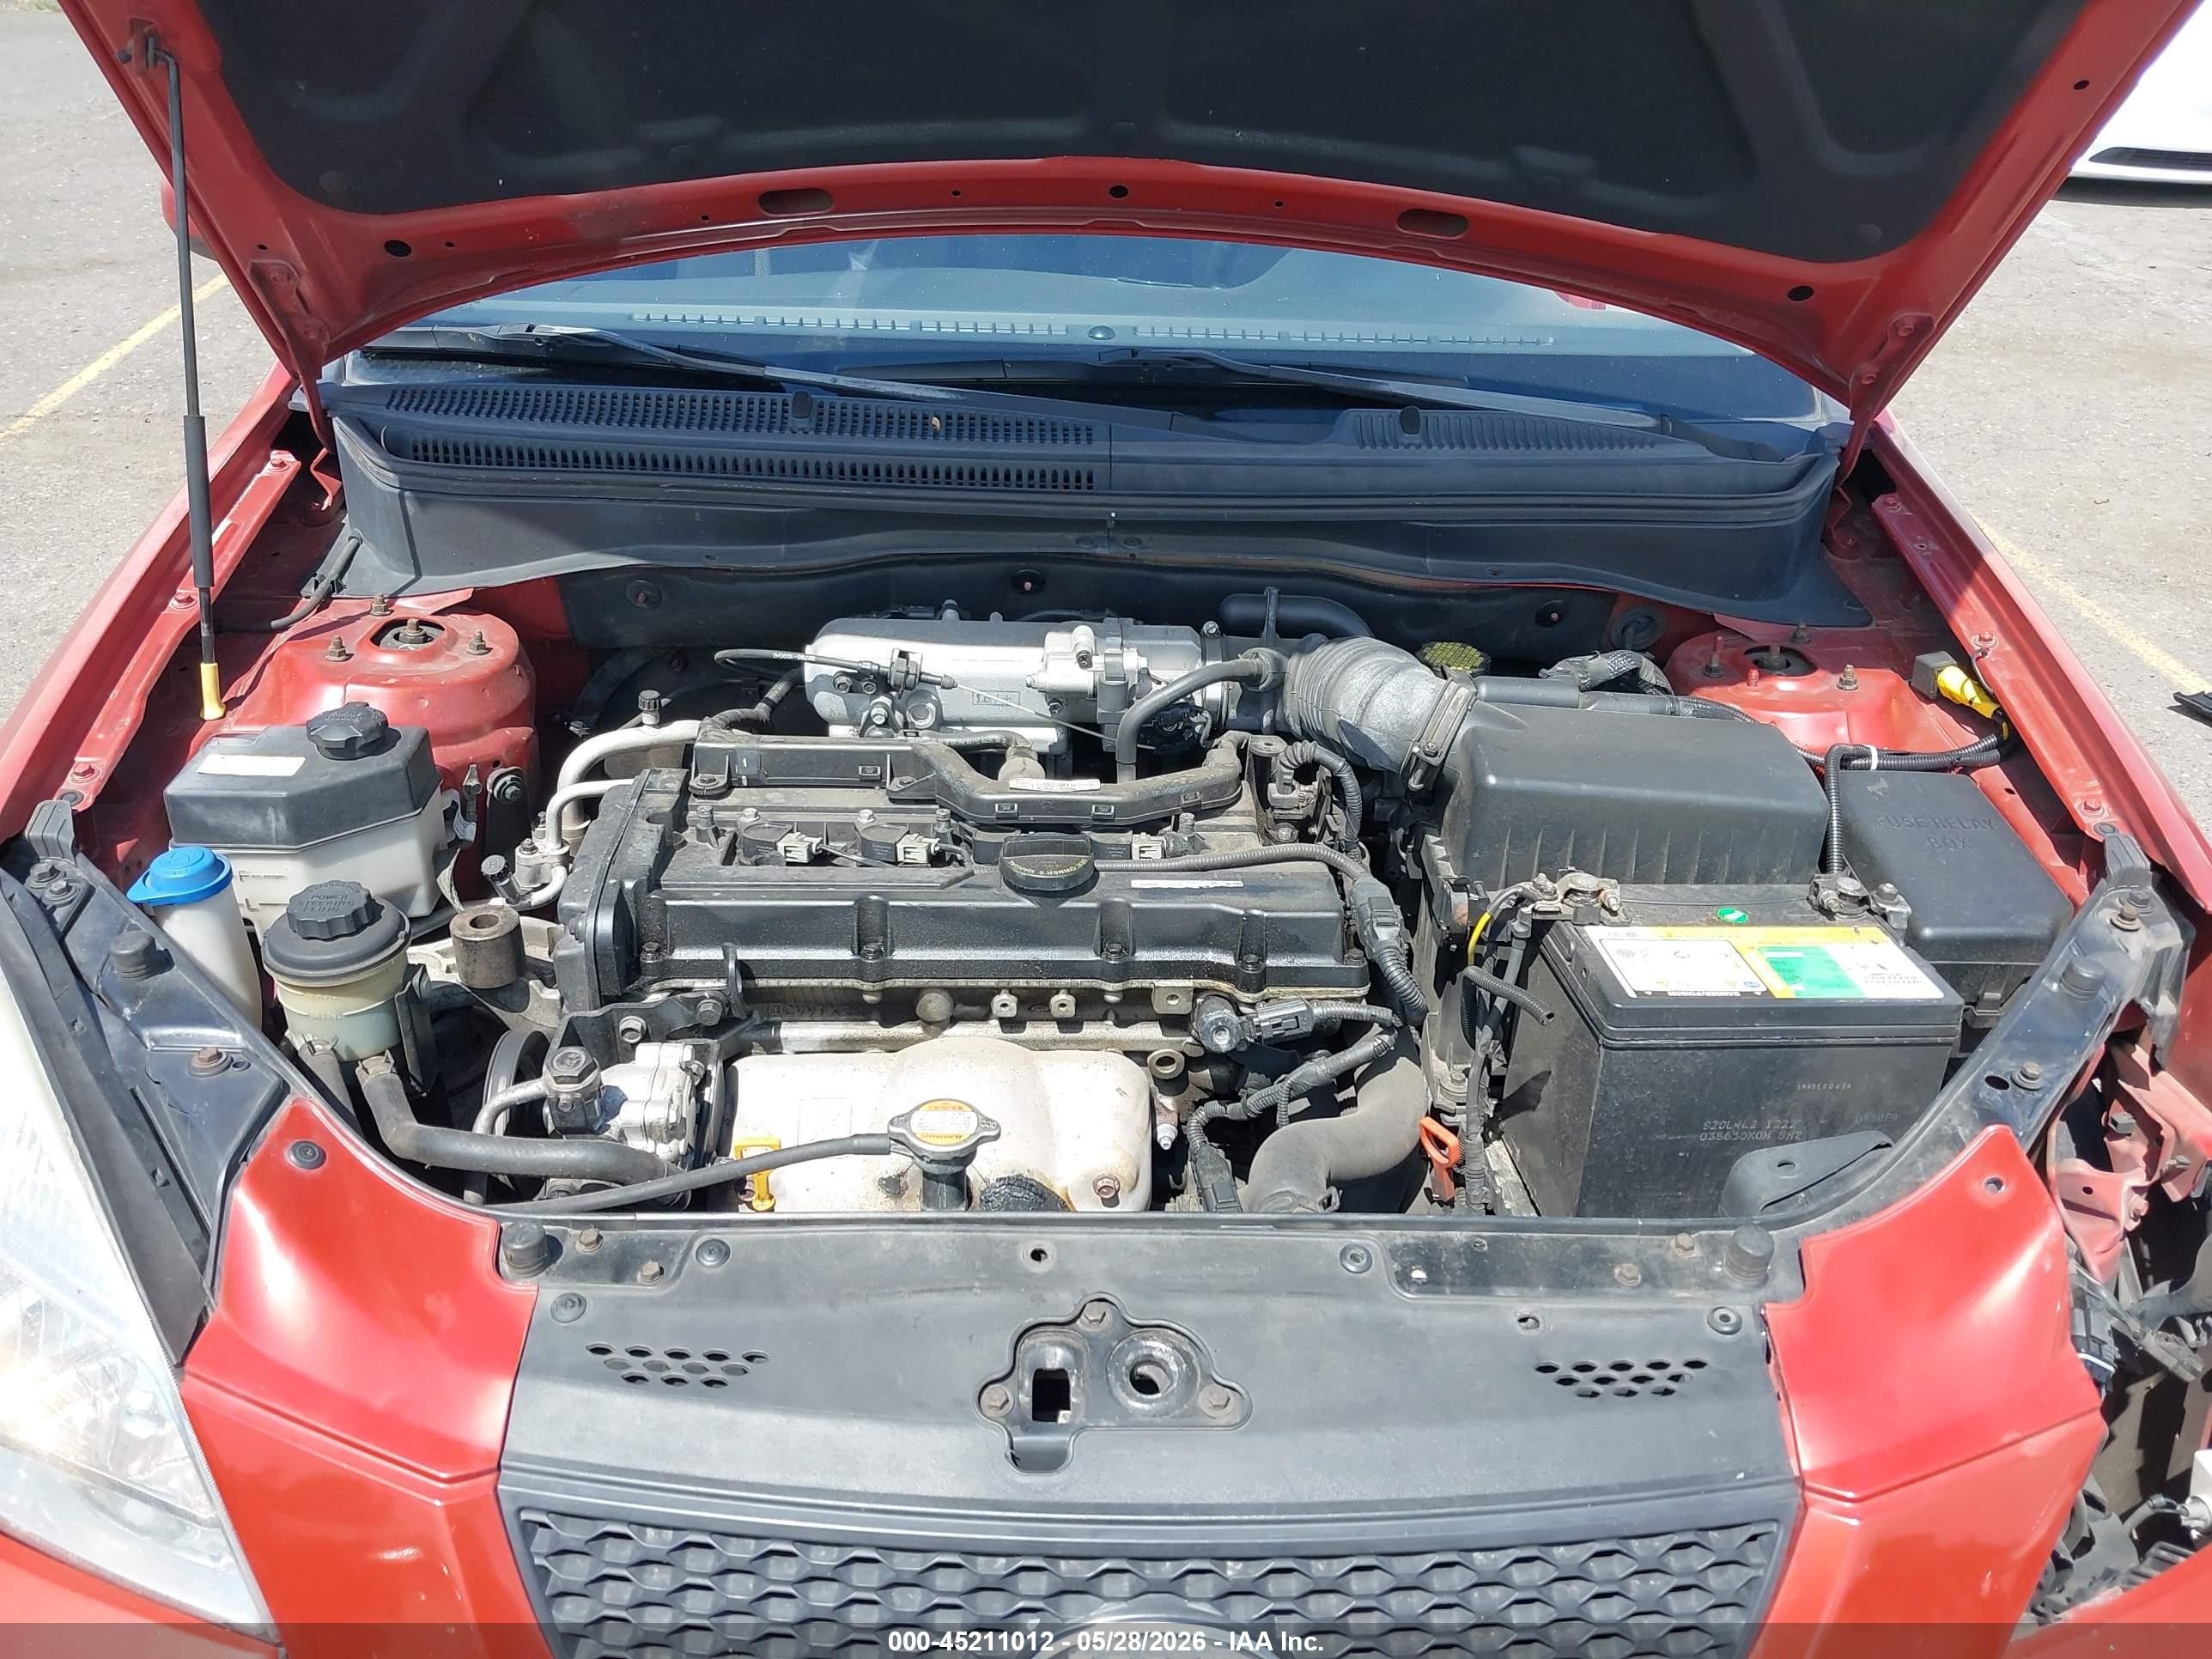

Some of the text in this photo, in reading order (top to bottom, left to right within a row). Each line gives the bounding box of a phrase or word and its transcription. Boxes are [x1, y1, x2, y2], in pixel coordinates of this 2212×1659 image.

[1875, 817, 1996, 830] FUSE RELAY
[1924, 836, 1973, 852] BOX
